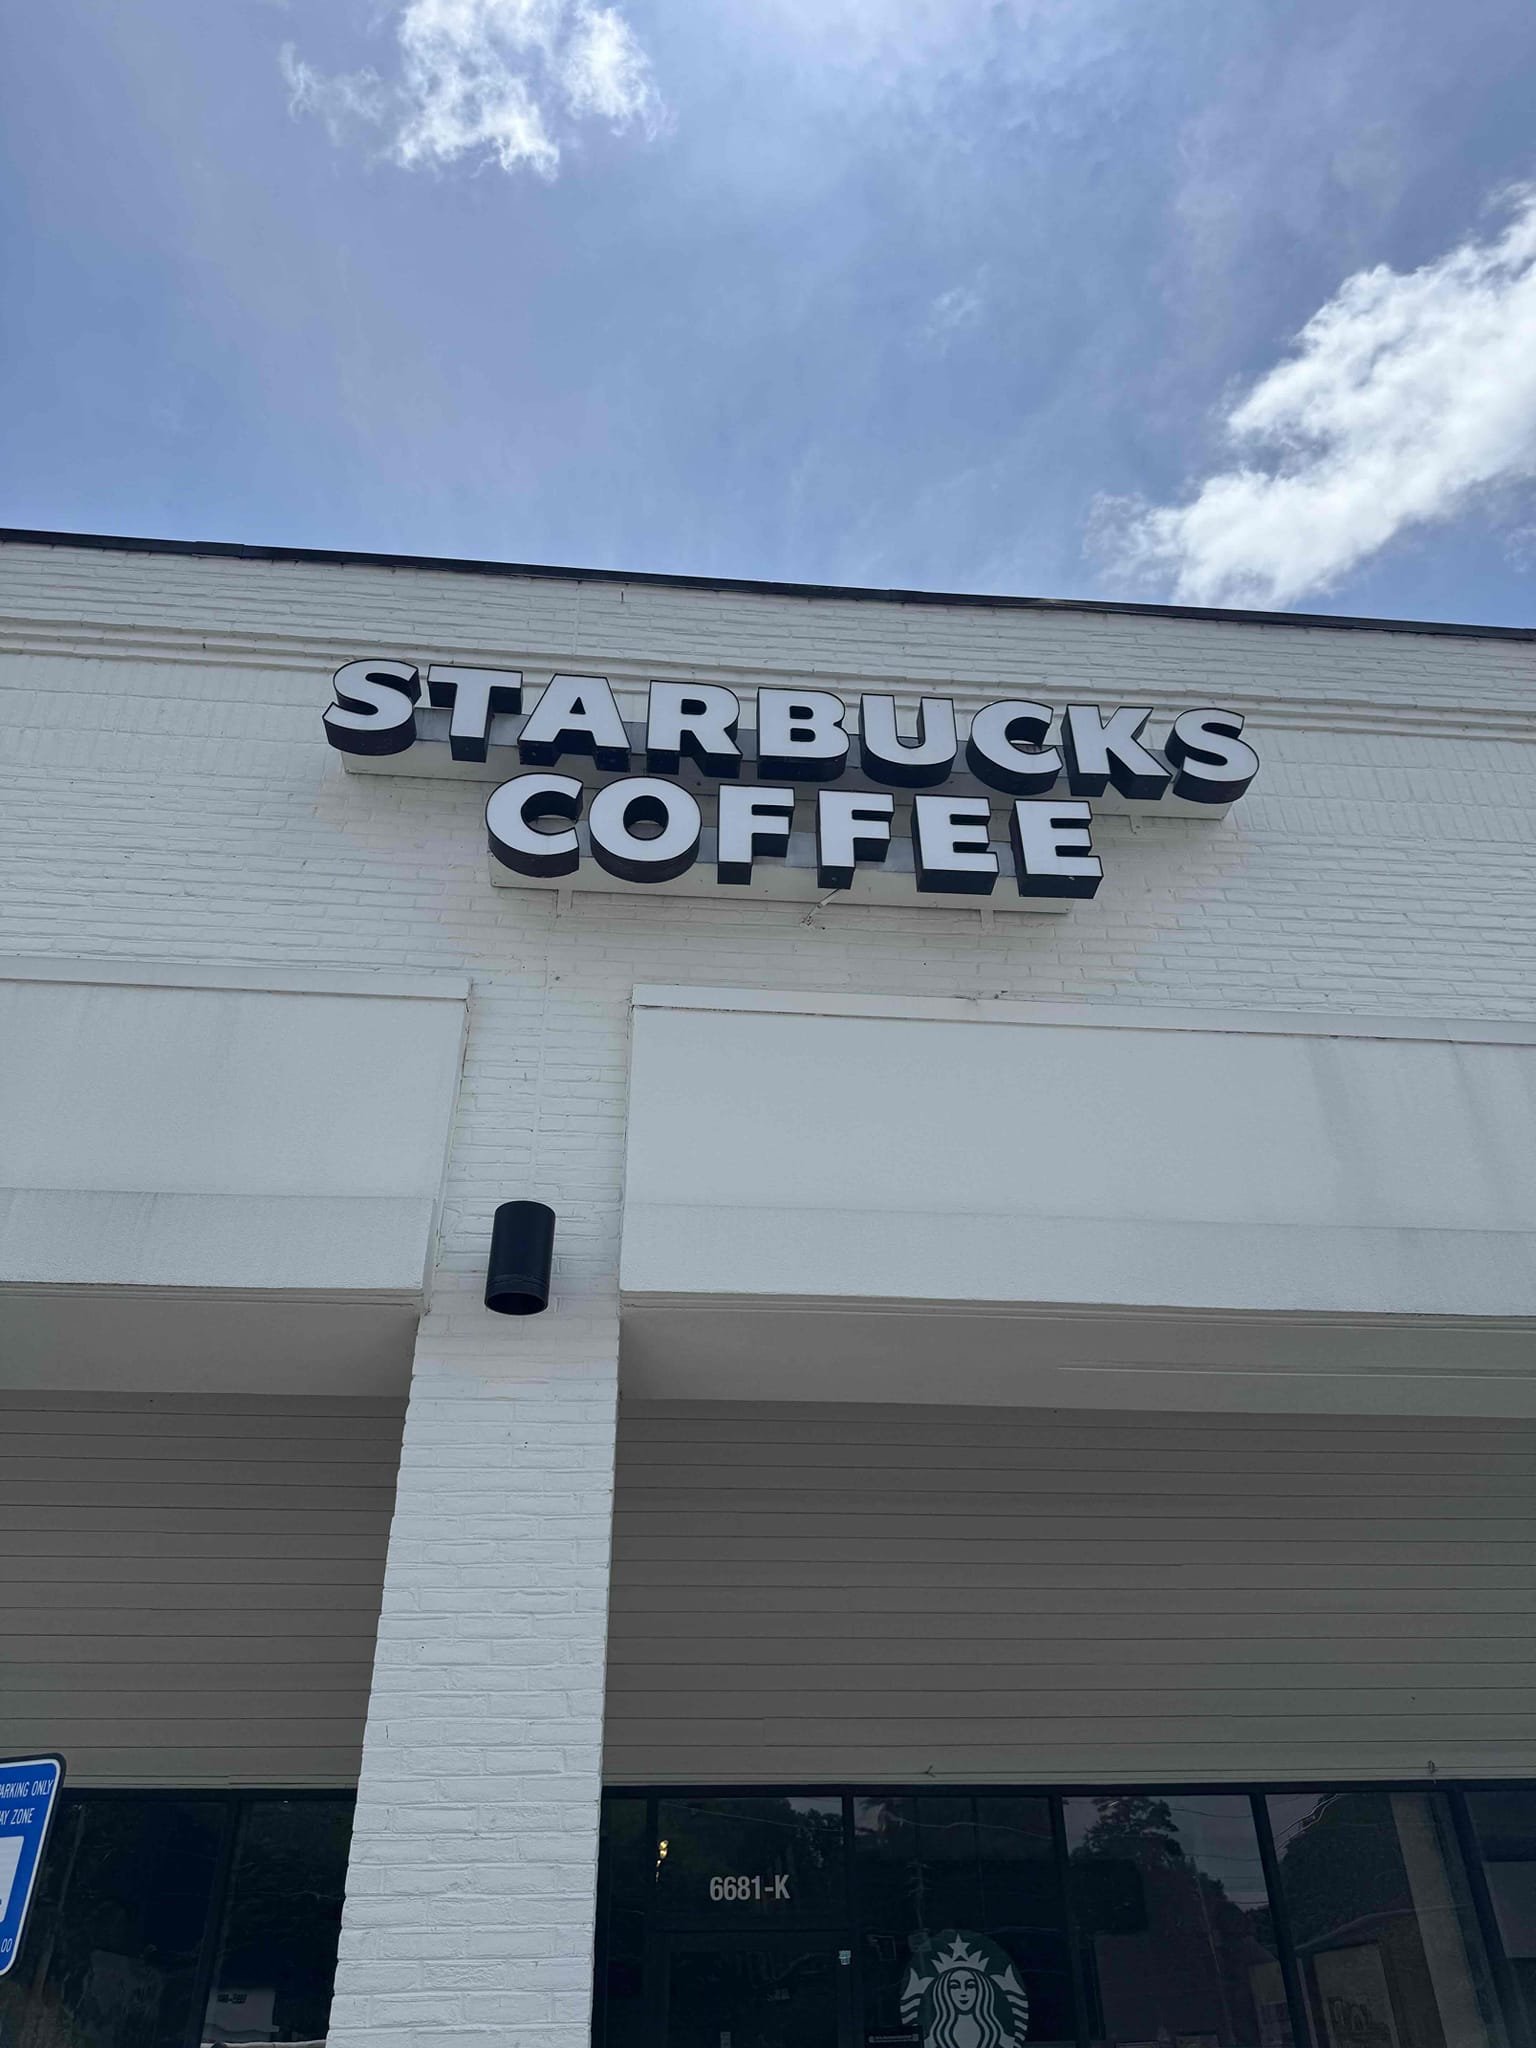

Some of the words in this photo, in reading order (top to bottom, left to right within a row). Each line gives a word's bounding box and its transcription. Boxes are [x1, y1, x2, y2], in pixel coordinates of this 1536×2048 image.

[322, 658, 1261, 804] STARBUCKS
[485, 772, 1104, 899] COFFEE
[0, 1781, 30, 1799] ARKING
[31, 1779, 54, 1797] ONLY
[10, 1807, 36, 1825] ZONE
[709, 1874, 791, 1901] 6681-K
